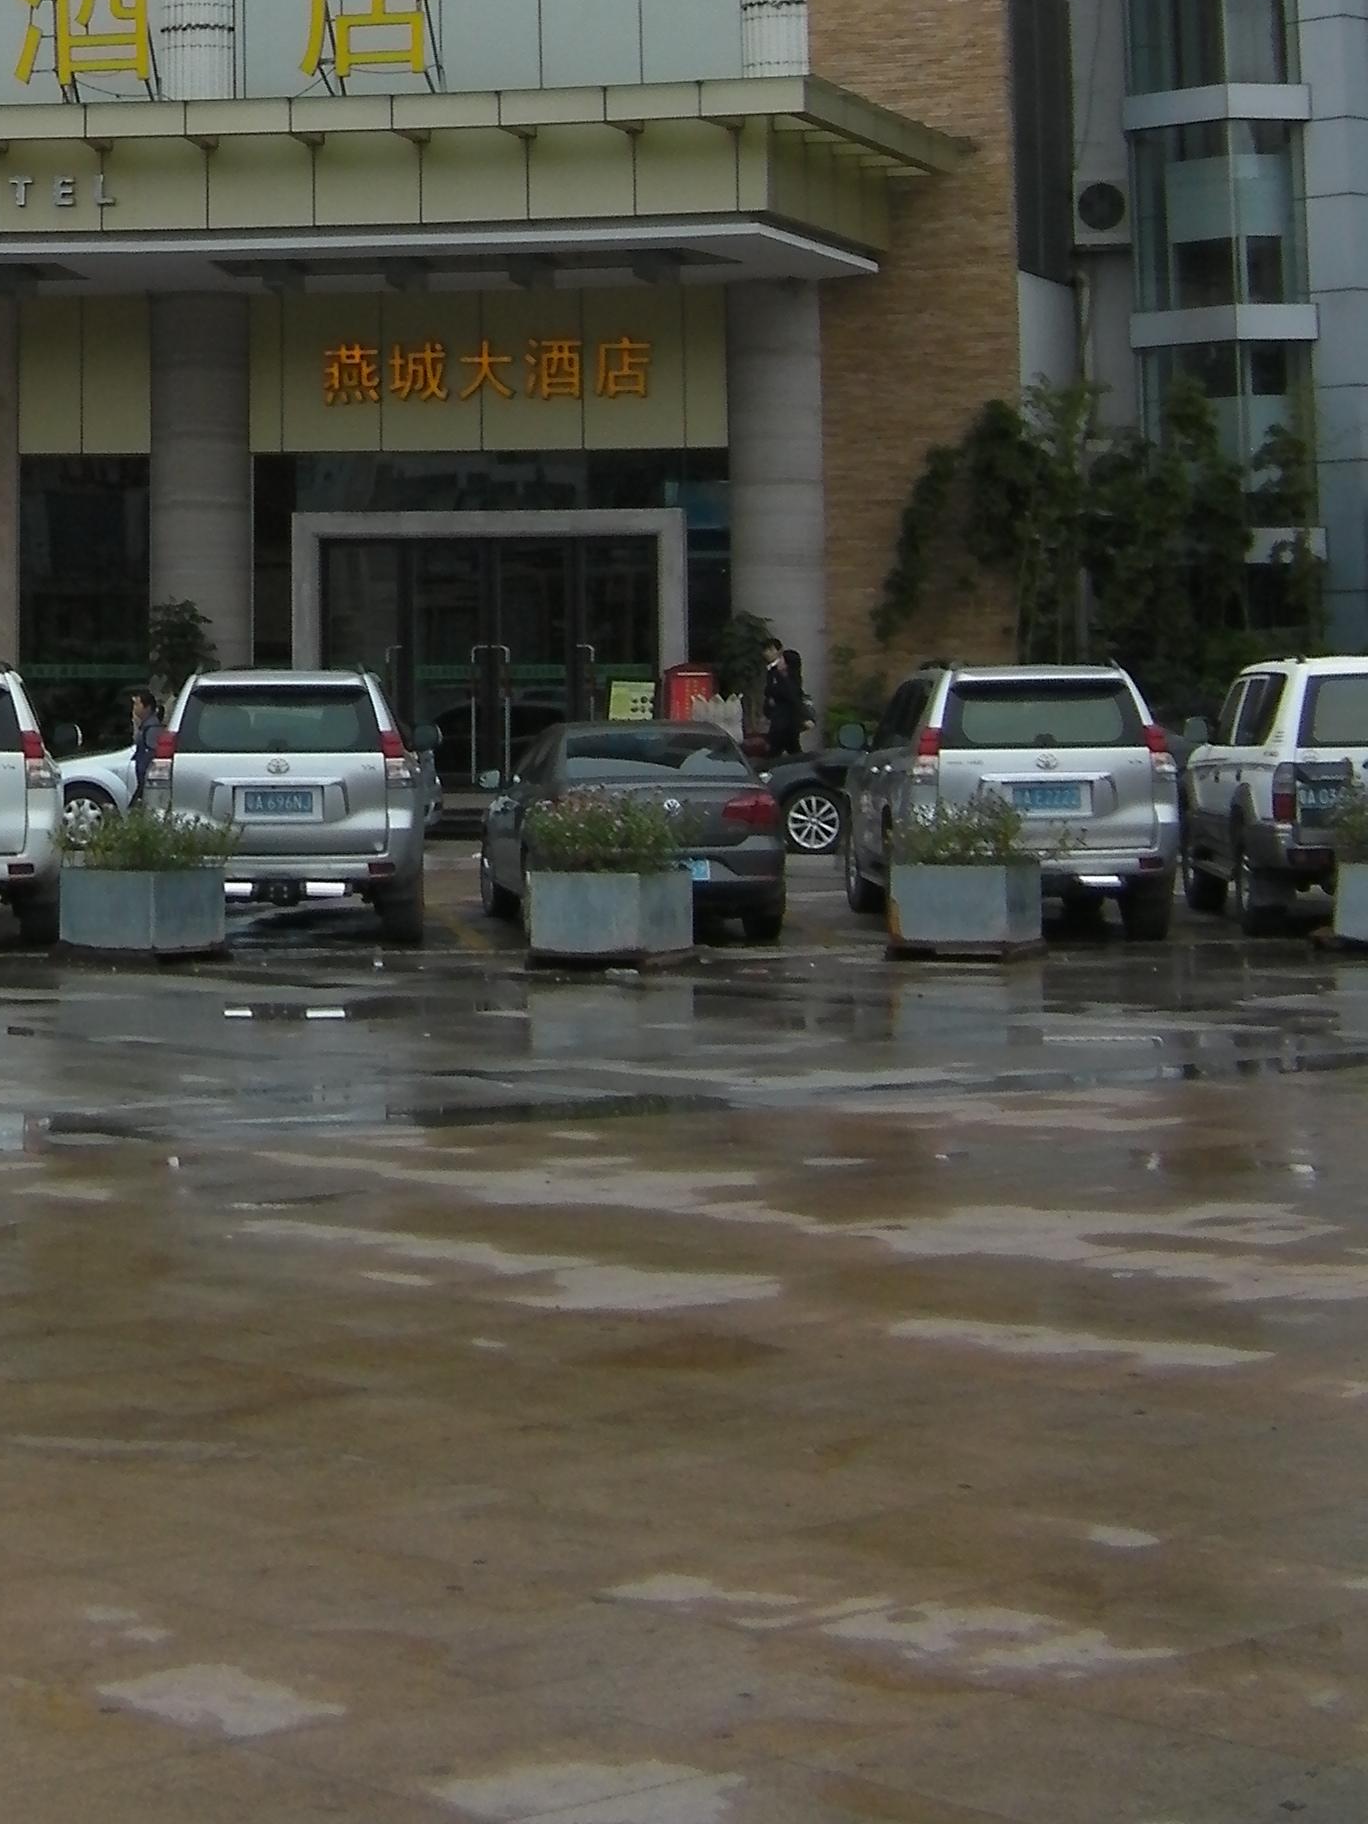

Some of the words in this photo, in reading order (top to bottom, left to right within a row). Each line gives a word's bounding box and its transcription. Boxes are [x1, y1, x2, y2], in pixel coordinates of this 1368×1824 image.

[323, 336, 654, 405] 燕城大酒店
